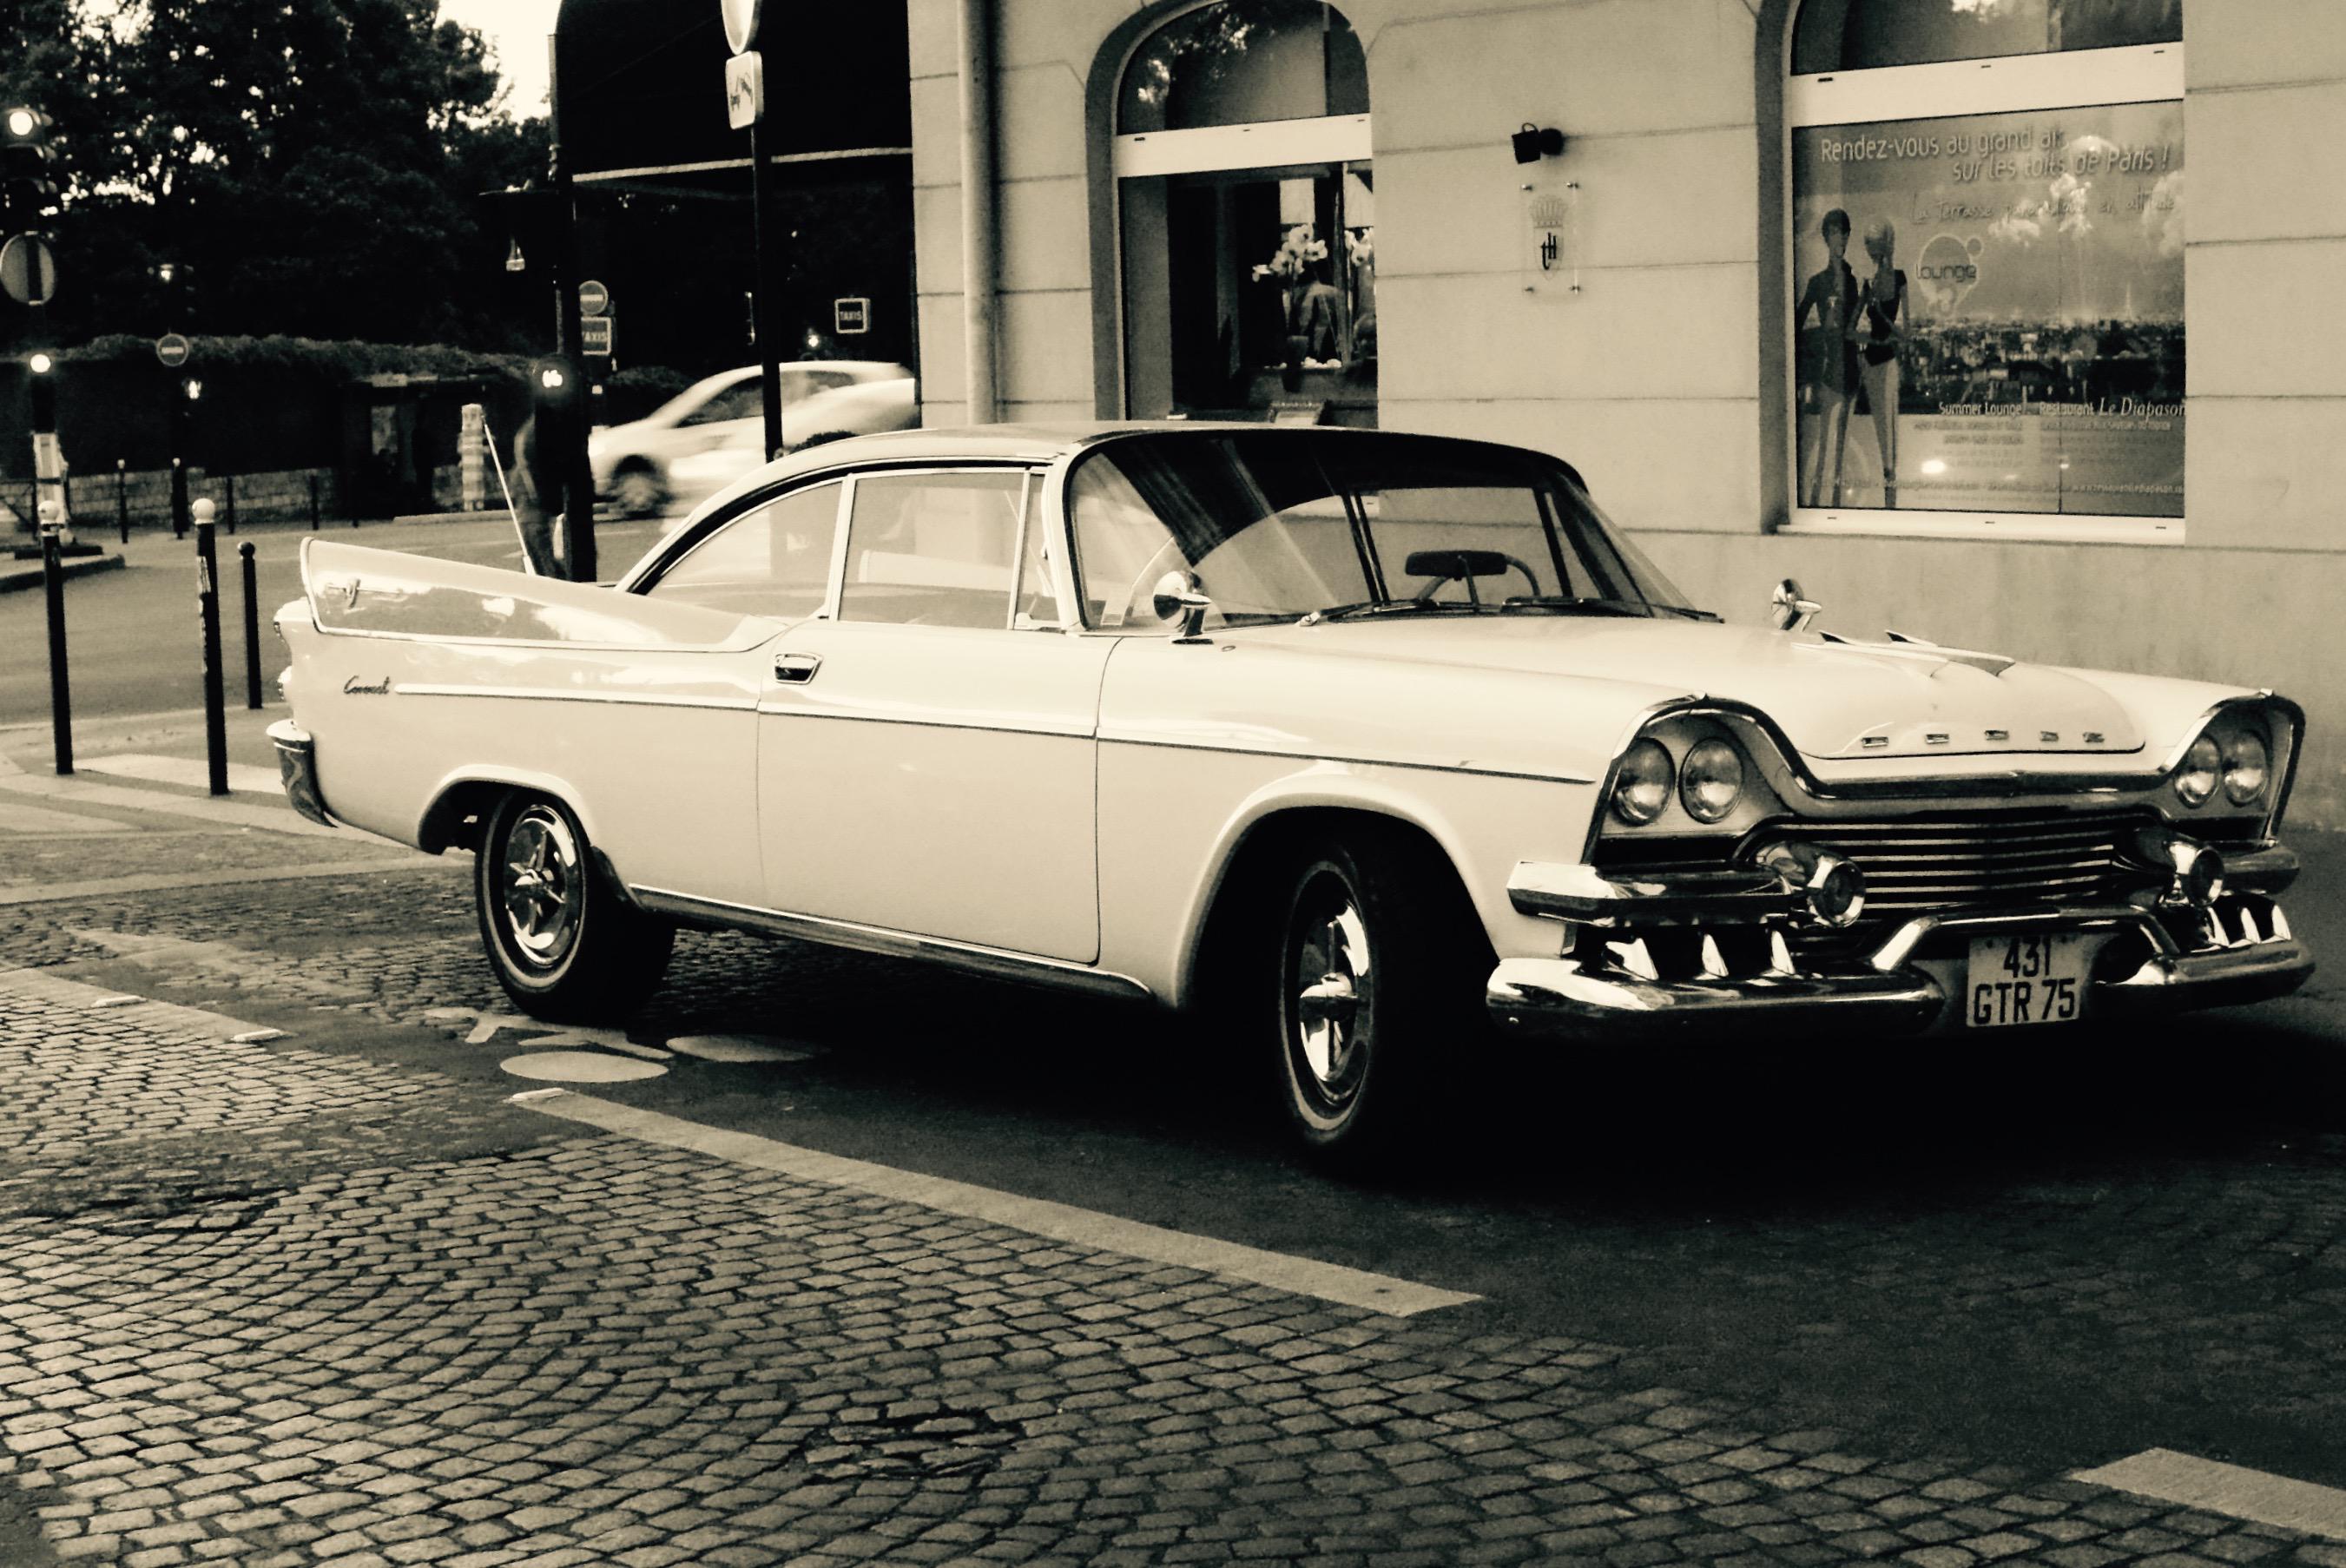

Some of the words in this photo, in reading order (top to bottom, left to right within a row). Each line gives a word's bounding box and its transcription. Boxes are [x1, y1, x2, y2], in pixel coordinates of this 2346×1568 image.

[1821, 135, 1940, 162] Rendez-vous
[1947, 135, 1970, 155] au
[1979, 127, 2032, 158] grand
[1954, 160, 1980, 181] sur
[1988, 153, 2016, 179] les
[2075, 151, 2099, 175] de
[2106, 146, 2154, 172] Paris
[1915, 263, 1977, 283] lounge
[582, 331, 608, 343] AXIS
[1939, 401, 1981, 415] Summer
[1985, 402, 2023, 417] Lounge
[2040, 401, 2094, 416] Restaurant
[2099, 397, 2116, 417] Le
[2003, 936, 2052, 978] 431
[1974, 981, 2032, 1024] GTR
[2041, 978, 2076, 1020] 75
